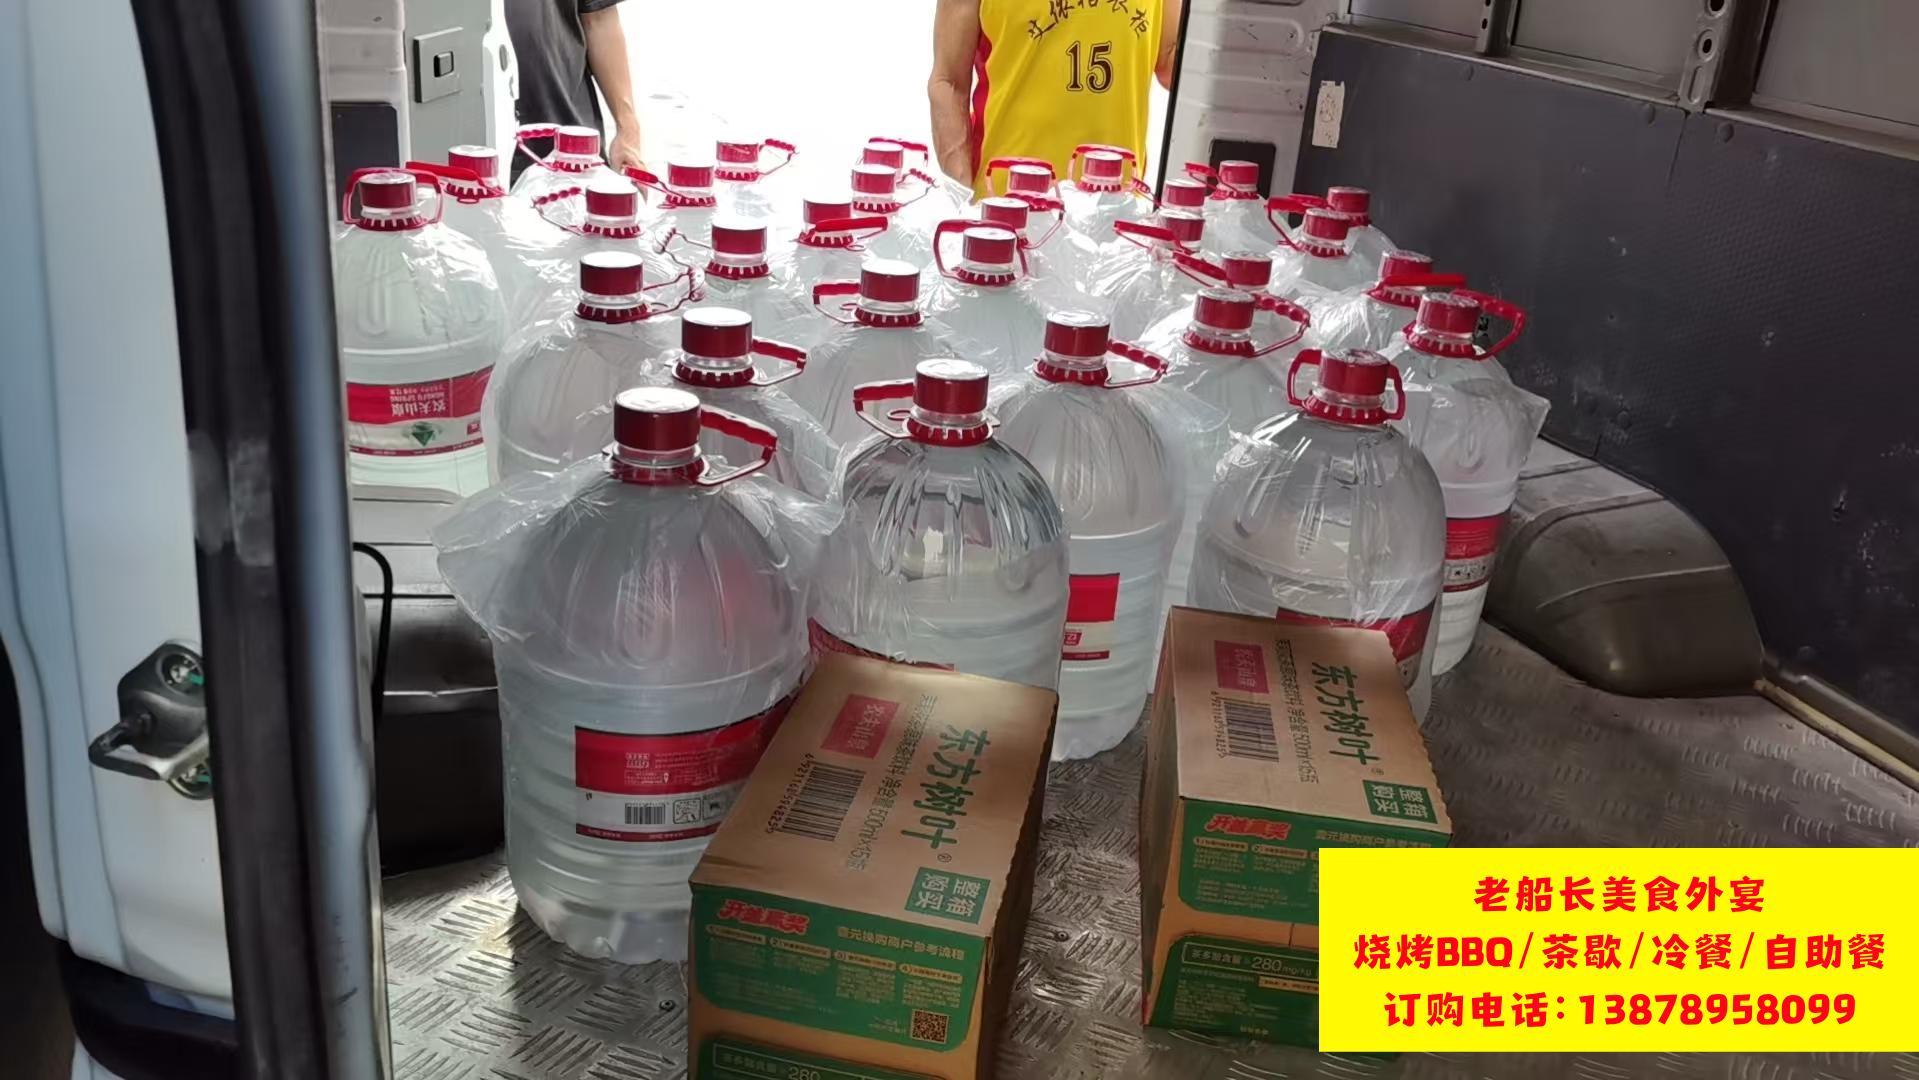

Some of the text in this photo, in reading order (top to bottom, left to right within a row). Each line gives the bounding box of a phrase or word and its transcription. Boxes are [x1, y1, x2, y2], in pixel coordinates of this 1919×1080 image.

[1066, 41, 1113, 93] 15
[1312, 661, 1381, 766] 东方树叶
[901, 724, 992, 850] 东方树叶
[1372, 783, 1400, 815] 购买
[1401, 786, 1429, 819] 整箱
[917, 872, 949, 911] 购买
[946, 877, 982, 918] 整箱
